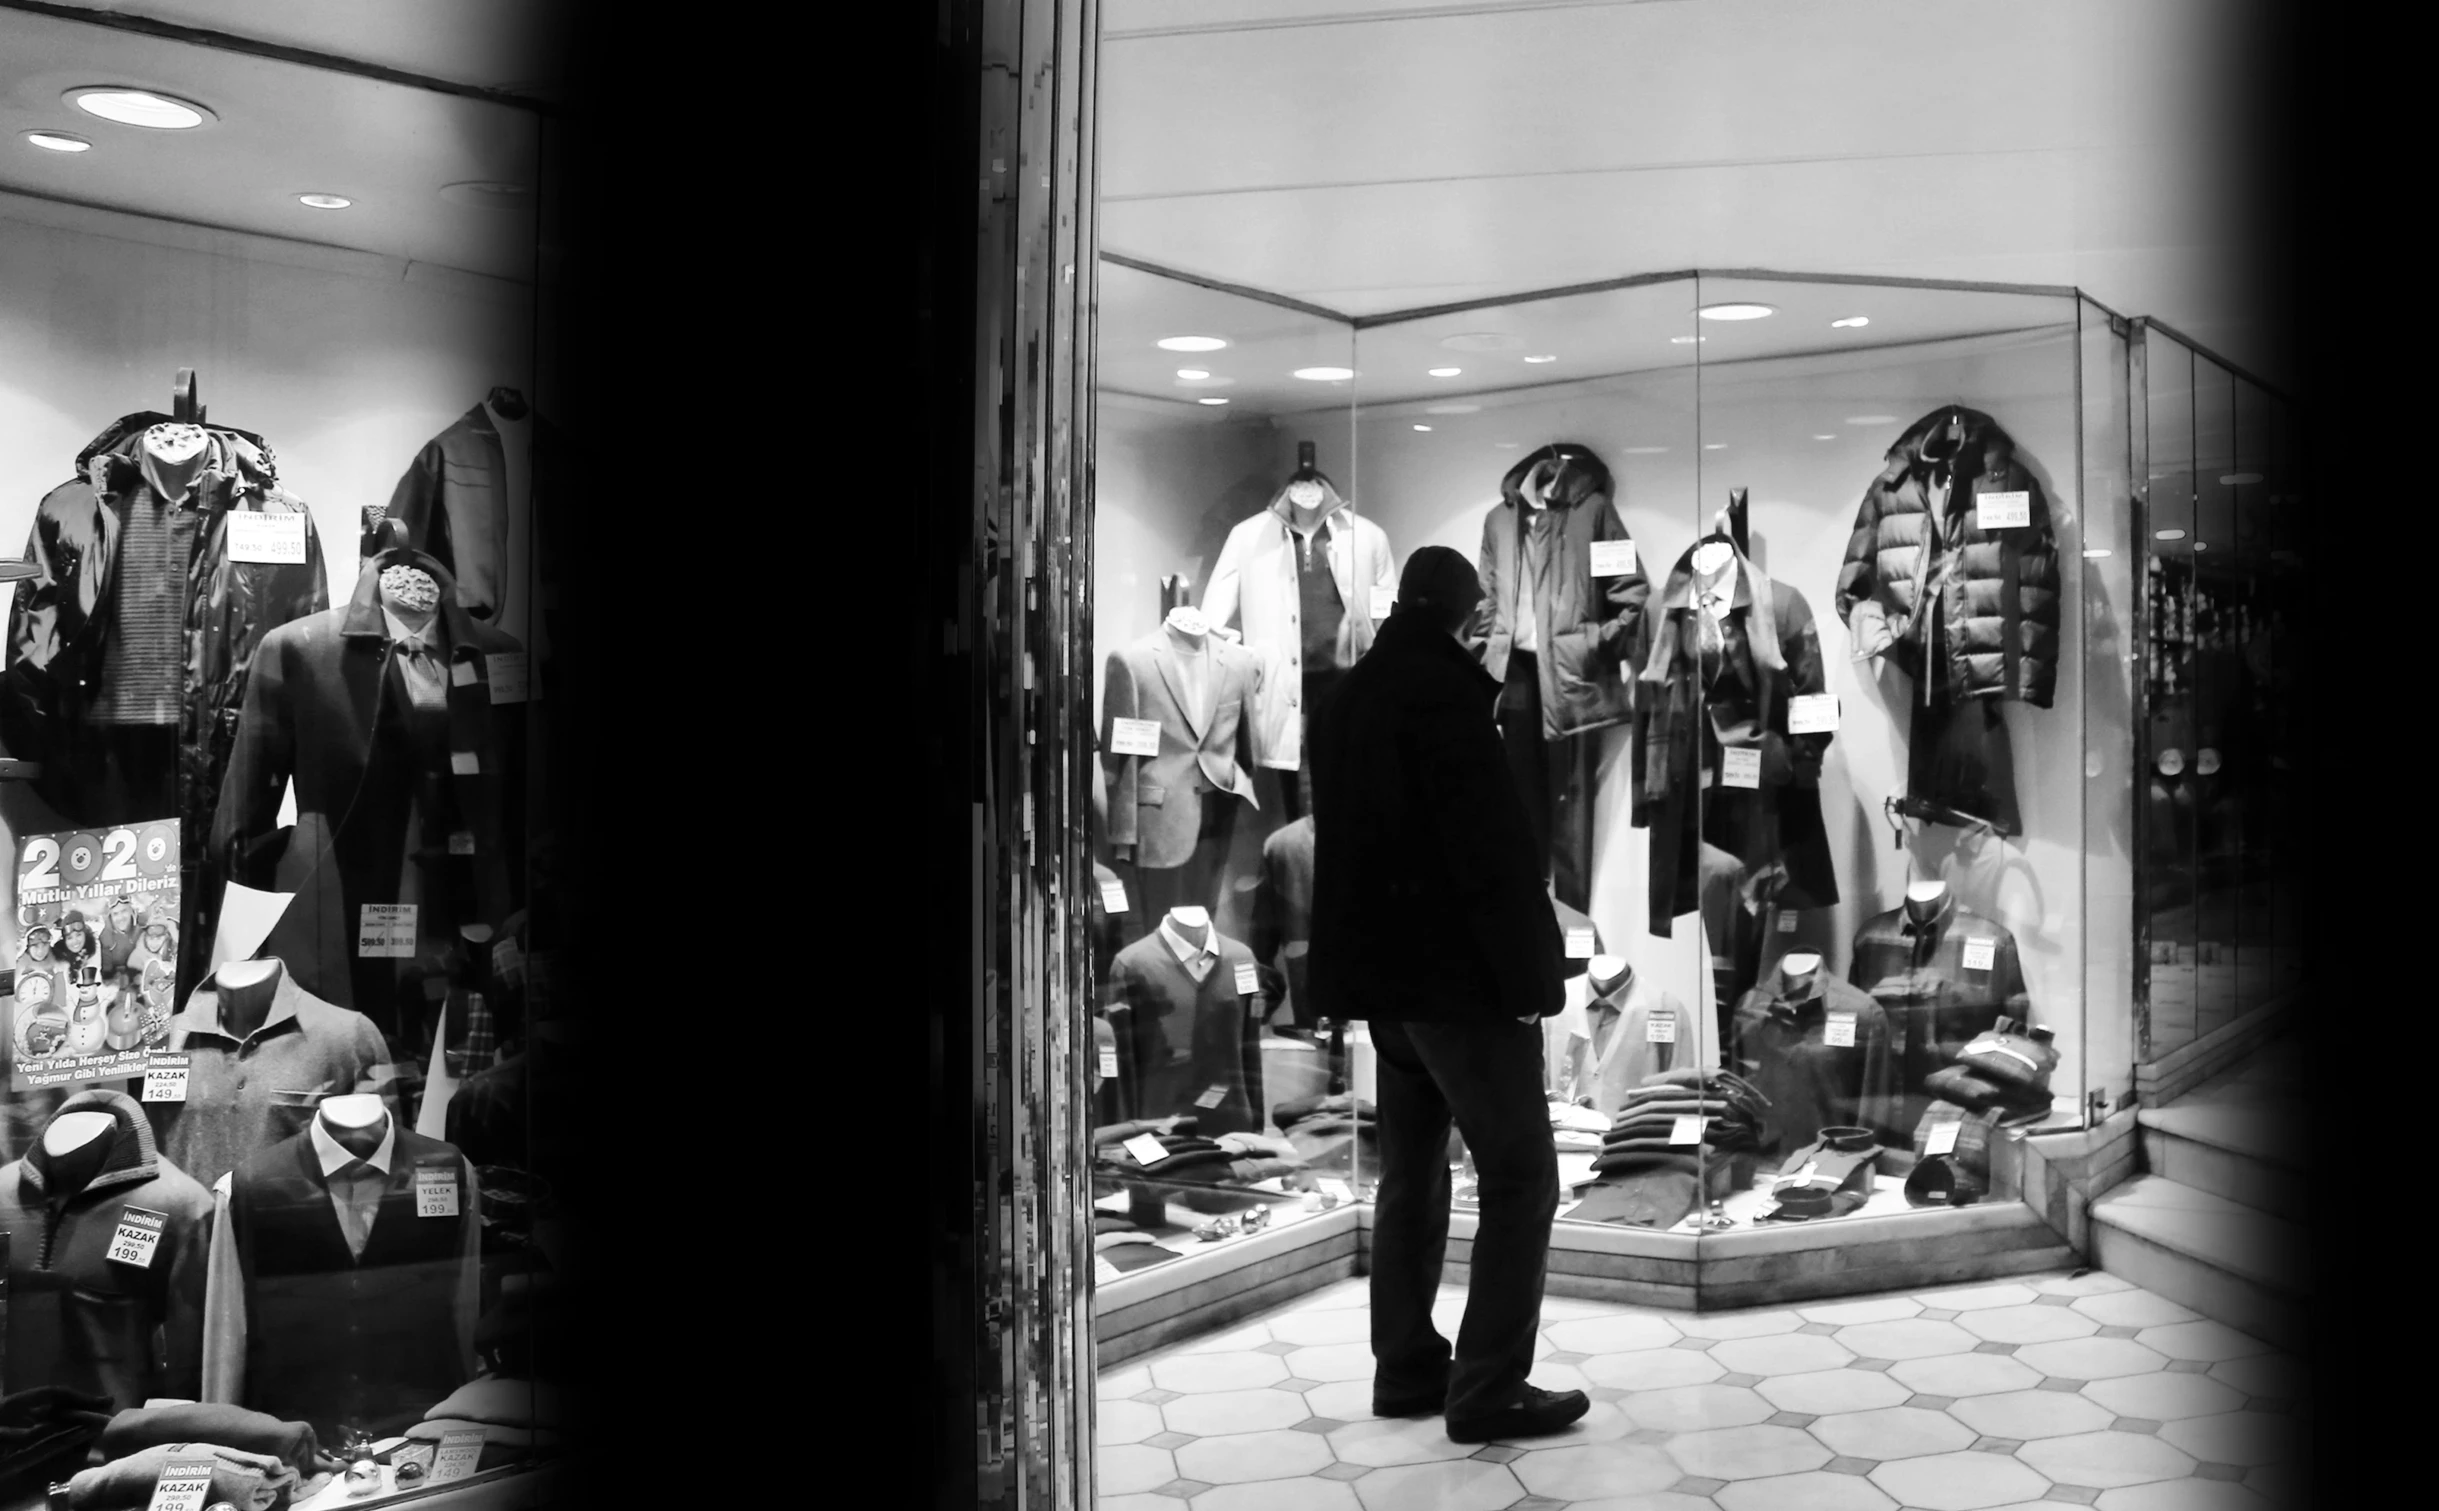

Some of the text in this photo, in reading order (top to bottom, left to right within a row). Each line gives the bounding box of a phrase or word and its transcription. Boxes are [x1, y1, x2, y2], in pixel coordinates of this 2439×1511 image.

[23, 824, 177, 890] 2020
[21, 876, 178, 906] Mutlu Yıllar Dileriz
[16, 1062, 44, 1073] Yeni
[47, 1059, 76, 1070] Yılda
[79, 1054, 116, 1067] Herşey
[119, 1050, 141, 1061] Size
[149, 1056, 189, 1066] İNDİRİM
[27, 1074, 72, 1085] Yağmur
[74, 1068, 96, 1080] Gibi
[417, 1171, 456, 1181] İNDİRİM
[123, 1211, 163, 1229] İNDİRİM
[118, 1227, 156, 1243] KAZAK
[440, 1453, 475, 1461] KAZAK
[165, 1465, 212, 1477] İNDİRİM
[159, 1482, 206, 1492] KAZAK
